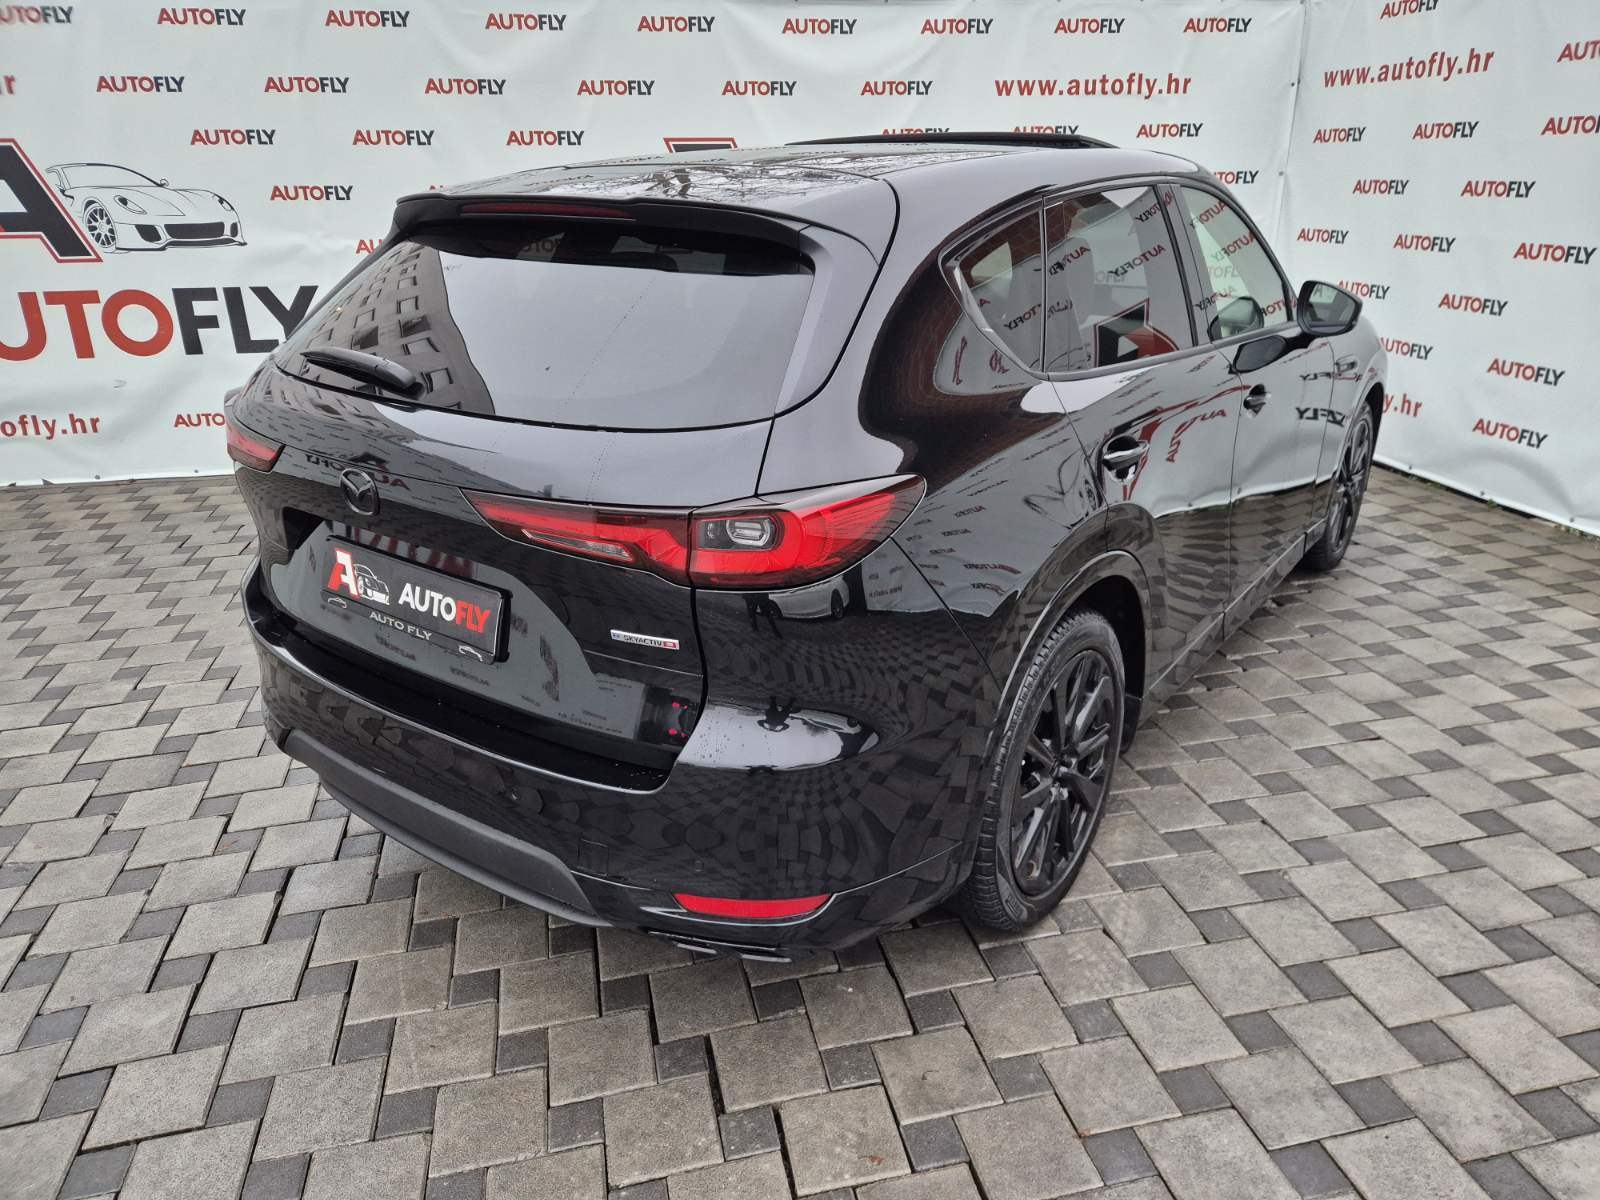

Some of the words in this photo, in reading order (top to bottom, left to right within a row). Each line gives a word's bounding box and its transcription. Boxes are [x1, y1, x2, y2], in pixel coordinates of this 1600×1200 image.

[0, 6, 72, 23] UTOFLY
[158, 8, 246, 25] AUTOFLY
[325, 10, 409, 27] AUTOFLY
[485, 13, 566, 31] AUTOFLY
[638, 16, 715, 32] AUTOFLY
[782, 19, 857, 34] AUTOFLY
[921, 19, 993, 34] AUTOFLY
[1054, 18, 1125, 33] AUTOFLY
[1184, 17, 1252, 32] AUTOFLY
[1557, 40, 1600, 62] AUT
[1325, 48, 1494, 88] www.autofly.hr
[97, 76, 184, 92] AUTOFLY
[264, 77, 349, 93] AUTOFLY
[425, 78, 506, 95] AUTOFLY
[577, 80, 655, 95] AUTOFLY
[722, 81, 797, 96] AUTOFLY
[861, 81, 933, 96] AUTOFLY
[995, 73, 1191, 99] www.autofly.hr
[191, 129, 275, 145] AUTOFLY
[353, 130, 434, 145] AUTOFLY
[506, 131, 584, 145] AUTOFLY
[1136, 123, 1203, 138] AUTOFLY
[1313, 127, 1366, 143] AUTOFLY
[1413, 121, 1479, 139] AUTOFLY
[1215, 170, 1259, 185] TOFLY
[270, 186, 353, 200] AUTOFLY
[1353, 180, 1409, 195] AUTOFLY
[1461, 181, 1536, 198] AUTOFLY
[1297, 228, 1349, 244] AUTOFLY
[1394, 235, 1456, 253] AUTOFLY
[1514, 243, 1597, 264] AUTOFLY
[1438, 294, 1508, 316] AUTOFLY
[0, 285, 318, 361] UTOFLY
[1379, 337, 1433, 360] UTOFLY
[1487, 359, 1565, 386] AUTOFLY
[0, 414, 99, 440] ofly.hr
[174, 413, 224, 427] AUTO
[1473, 419, 1548, 448] AUTOFLY
[398, 582, 491, 634] AUTOFLY
[369, 611, 404, 631] AUTO
[407, 625, 433, 641] FLY
